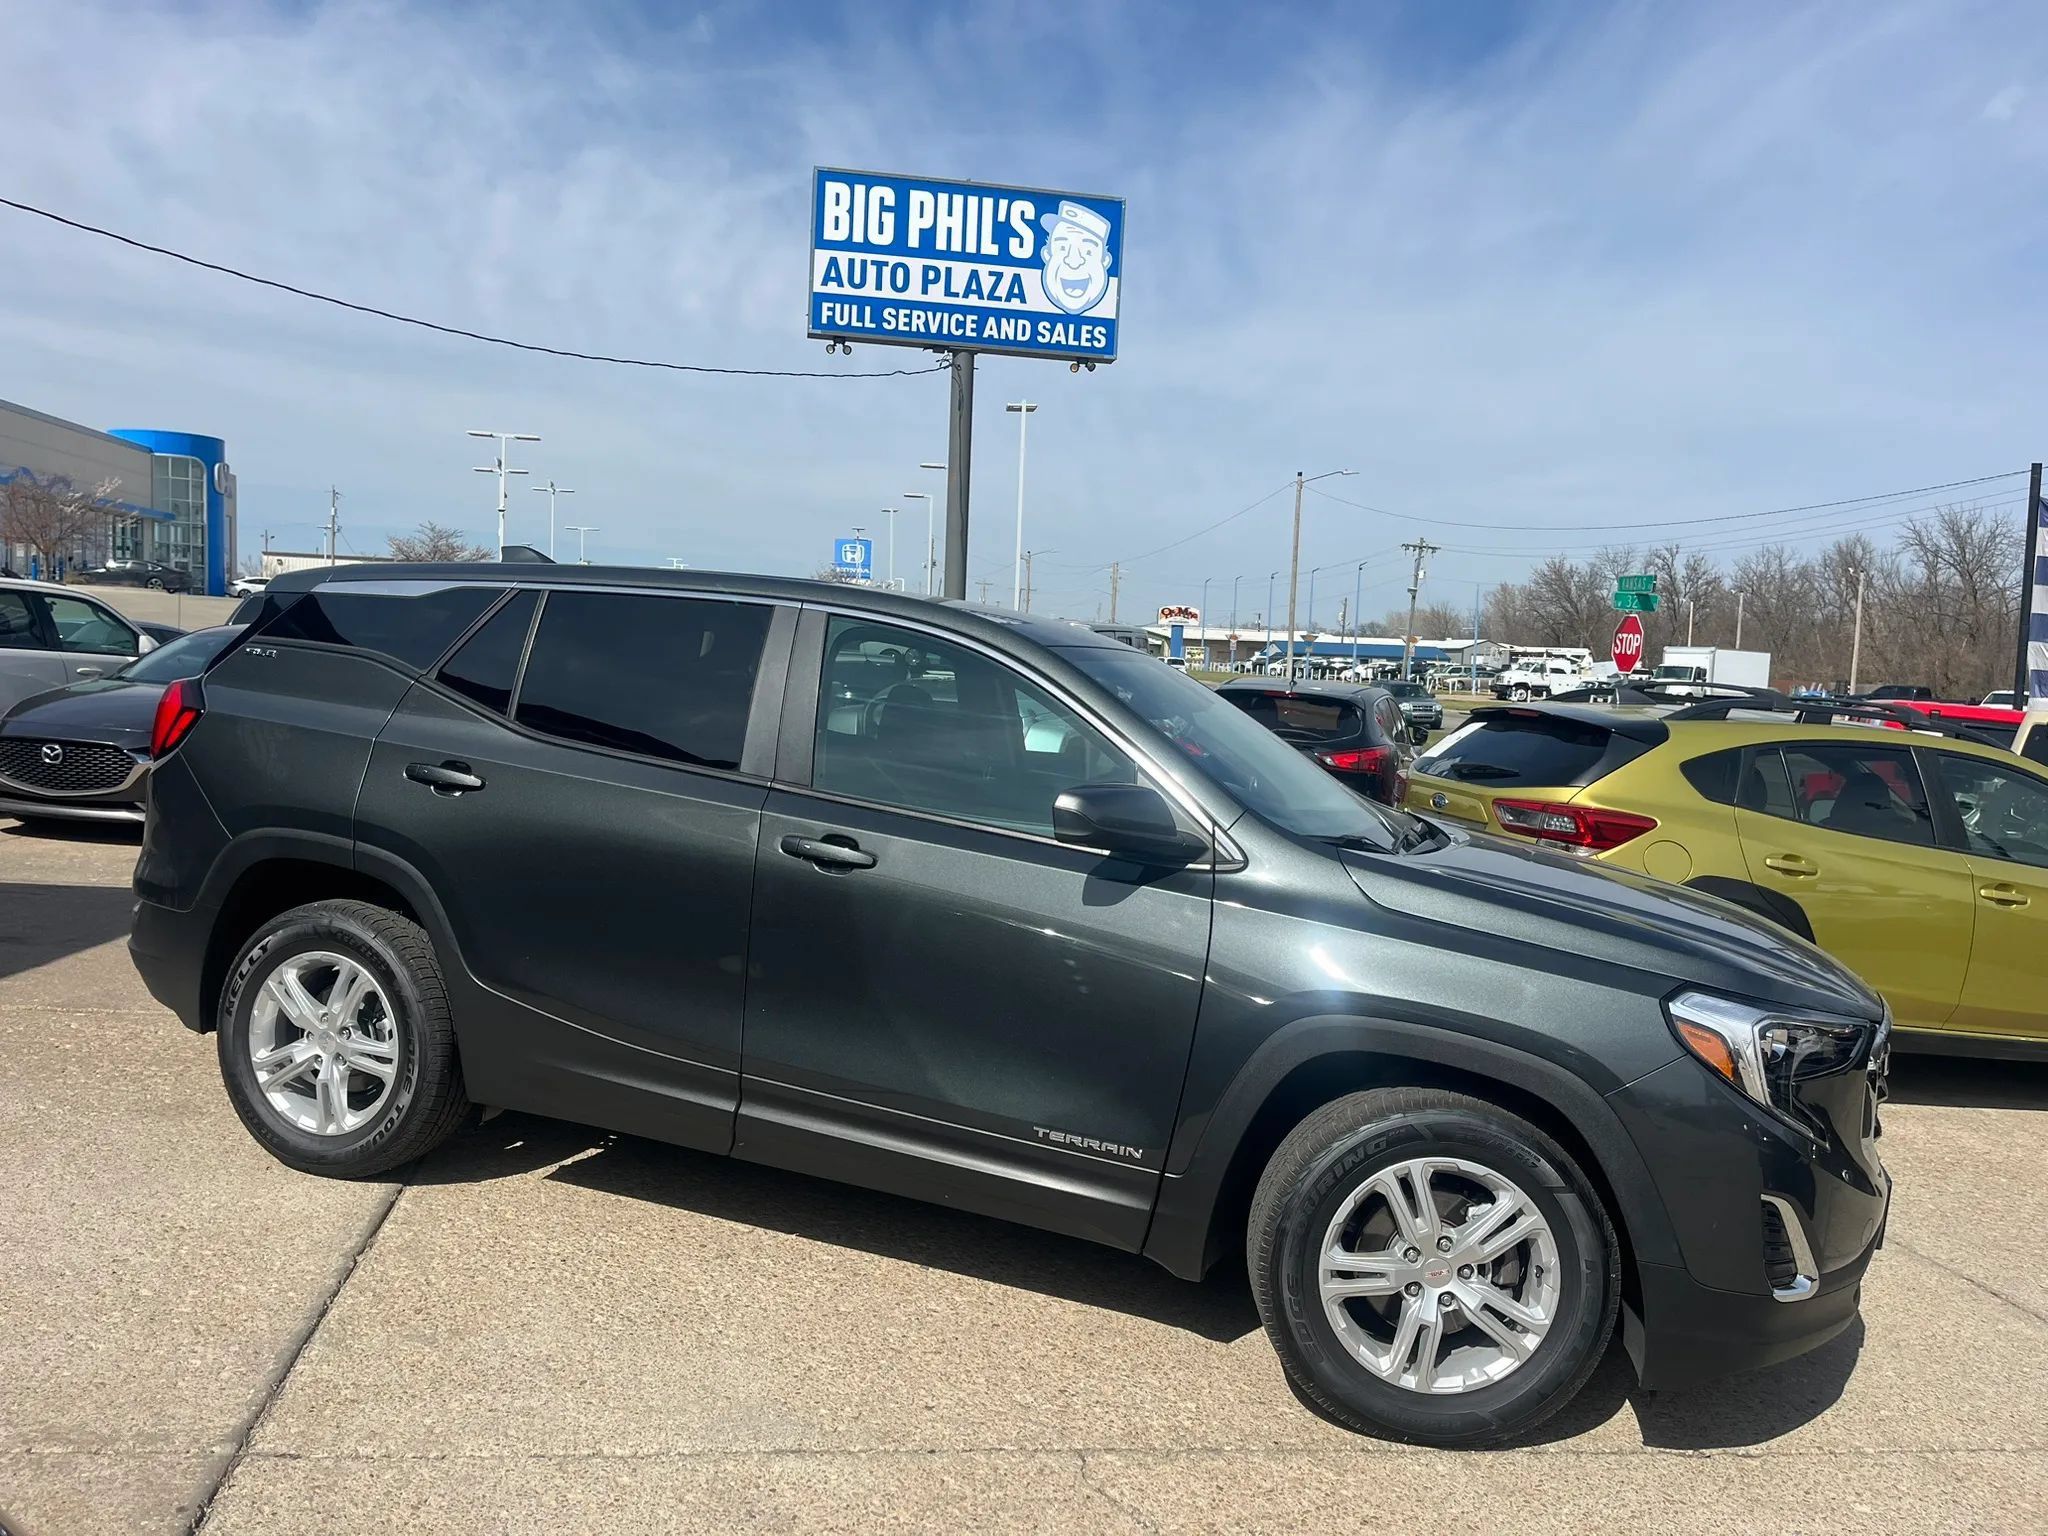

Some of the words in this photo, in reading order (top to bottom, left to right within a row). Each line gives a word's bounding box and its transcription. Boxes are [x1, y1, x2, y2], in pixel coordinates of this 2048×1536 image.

[823, 180, 896, 246] BIG
[907, 189, 1036, 259] PHIL'S
[820, 256, 910, 294] AUTO
[920, 264, 1027, 305] PLAZA
[821, 302, 876, 328] FULL
[882, 306, 977, 337] SERVICE
[982, 316, 1032, 342] AND
[1037, 321, 1107, 349] SALES
[1614, 633, 1640, 655] STOP
[225, 939, 271, 1016] KELLY
[1033, 1126, 1143, 1160] TERRAIN
